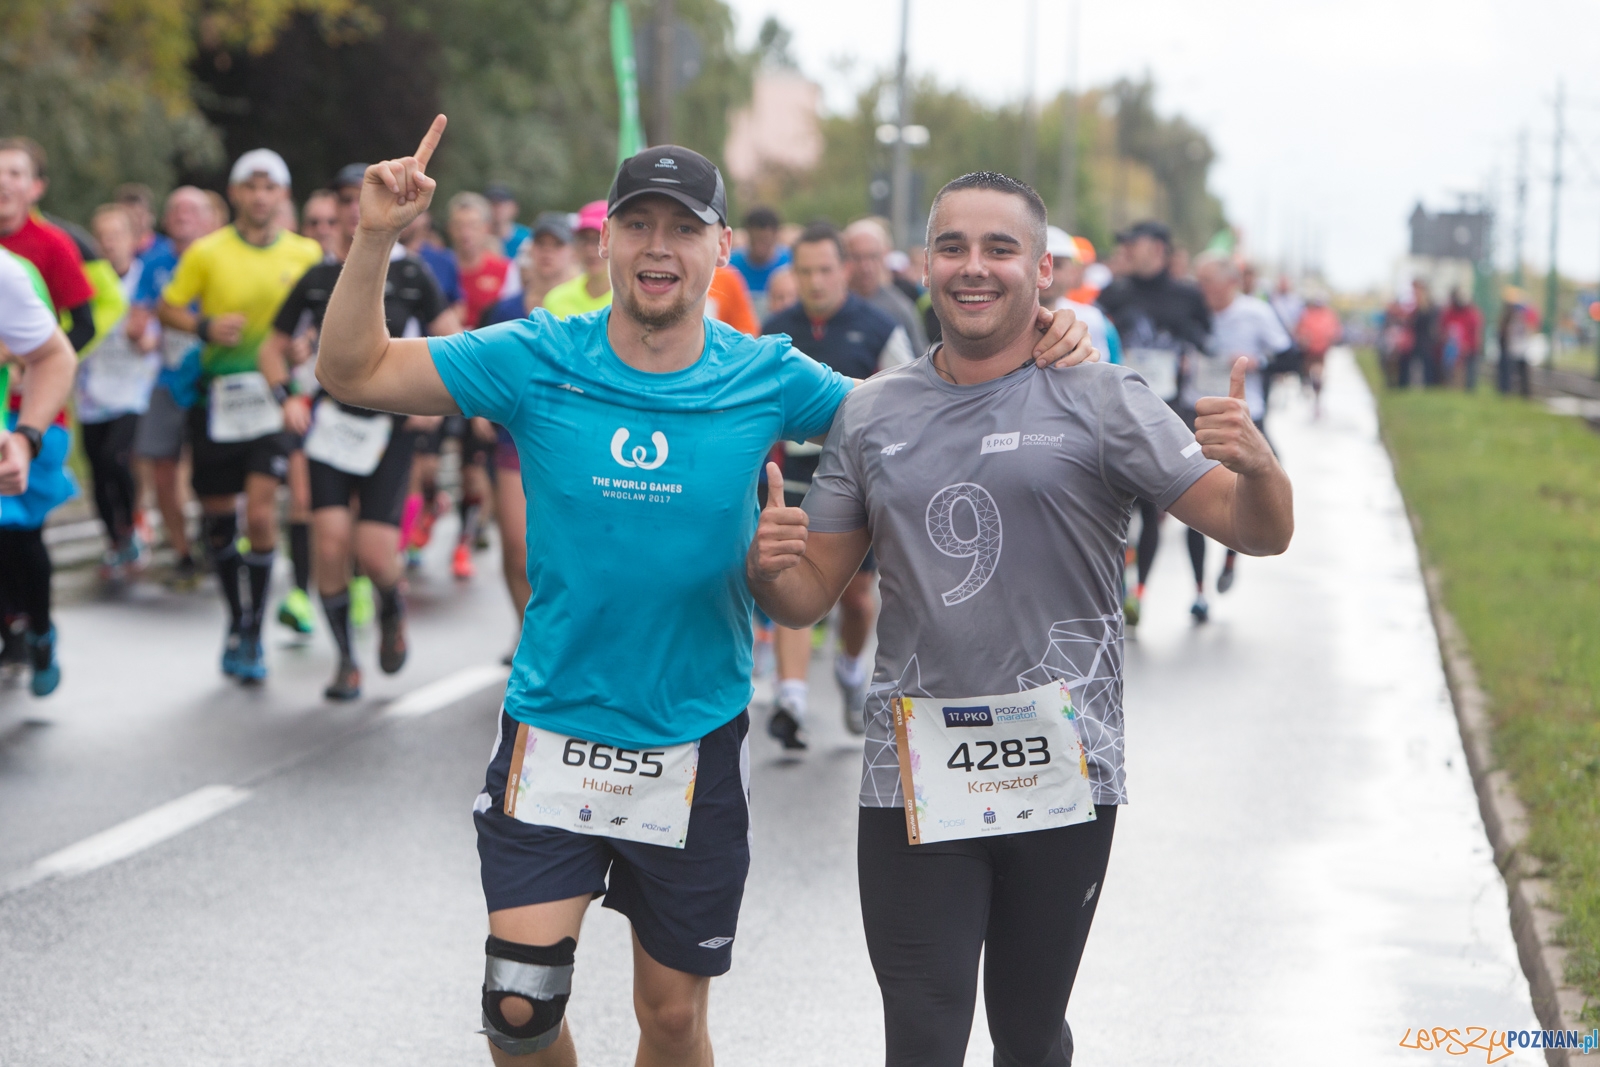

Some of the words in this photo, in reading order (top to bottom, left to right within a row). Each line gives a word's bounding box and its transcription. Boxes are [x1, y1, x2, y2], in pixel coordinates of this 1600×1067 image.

[993, 438, 1013, 447] PKO
[592, 476, 610, 487] THE
[612, 479, 647, 491] WORLD
[649, 482, 683, 494] GAMES
[648, 494, 671, 504] 2017
[996, 711, 1038, 722] maraton
[562, 737, 665, 778] 6655
[947, 736, 1051, 773] 4283
[582, 777, 634, 796] Hubert
[967, 774, 1039, 795] Krzysztof
[1016, 809, 1034, 820] 4F
